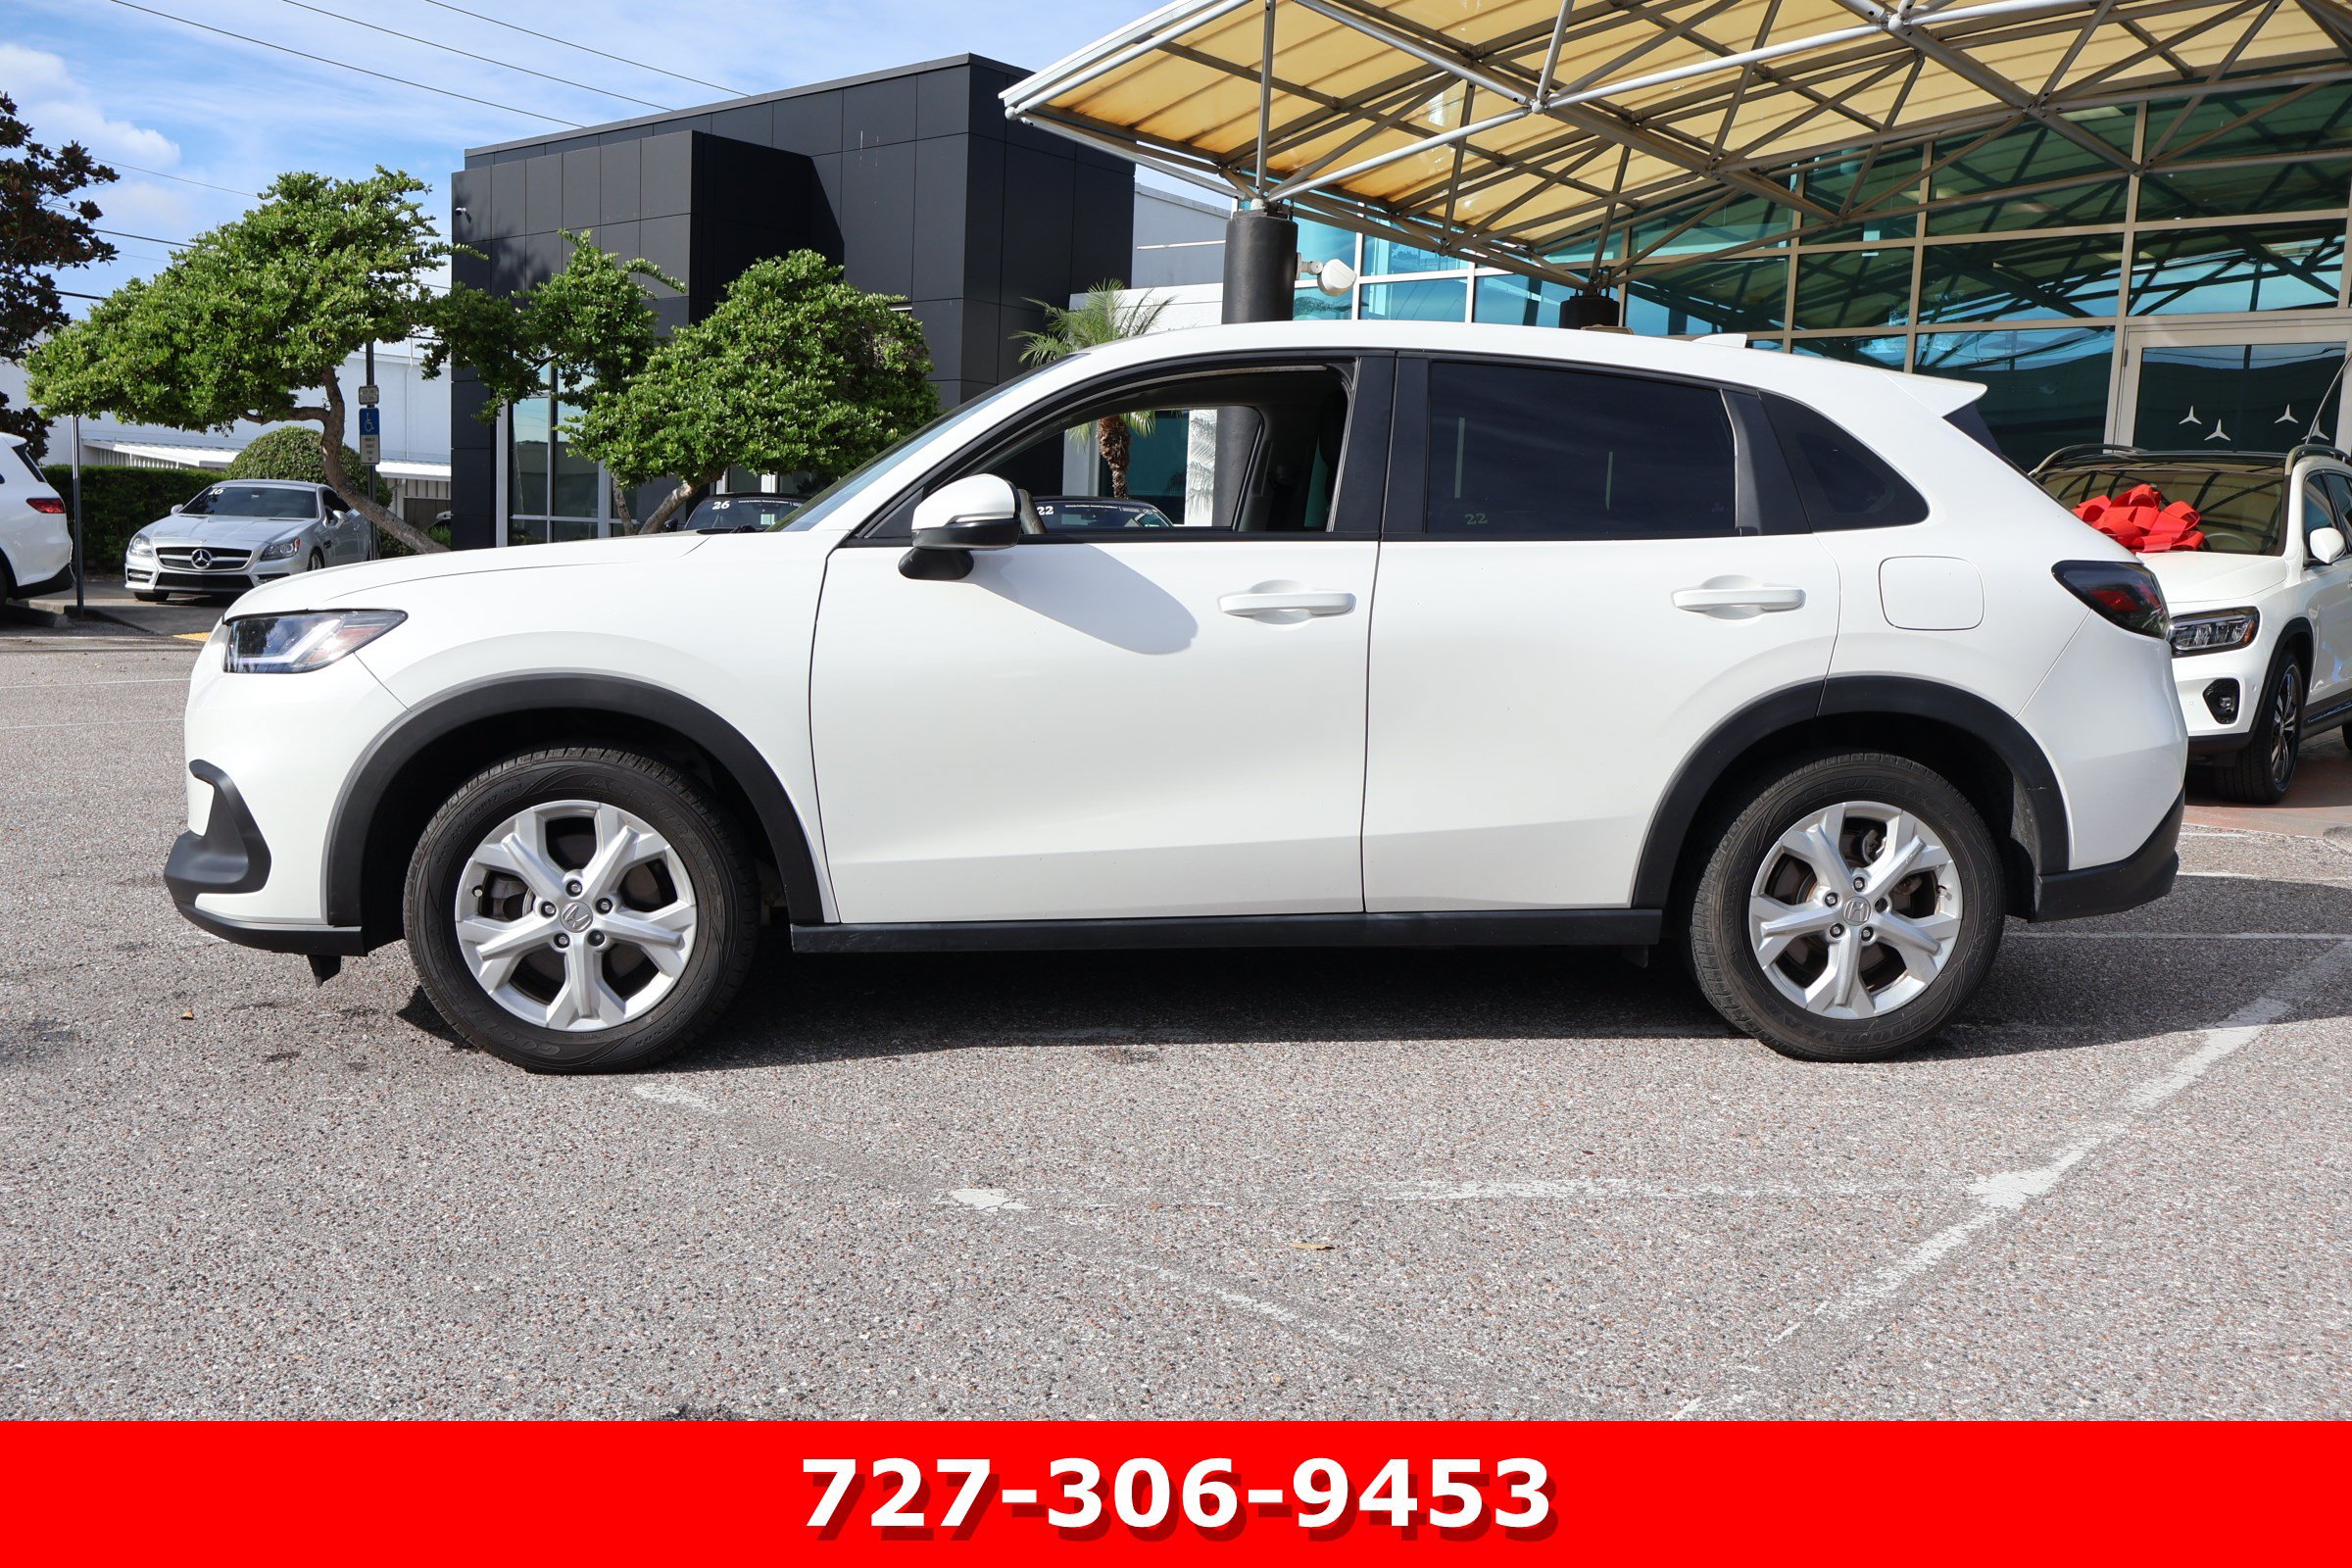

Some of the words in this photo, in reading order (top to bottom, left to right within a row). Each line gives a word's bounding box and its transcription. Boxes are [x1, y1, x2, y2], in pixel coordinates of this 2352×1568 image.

[711, 501, 731, 511] 26
[1036, 506, 1054, 515] 22
[1465, 513, 1489, 525] 22
